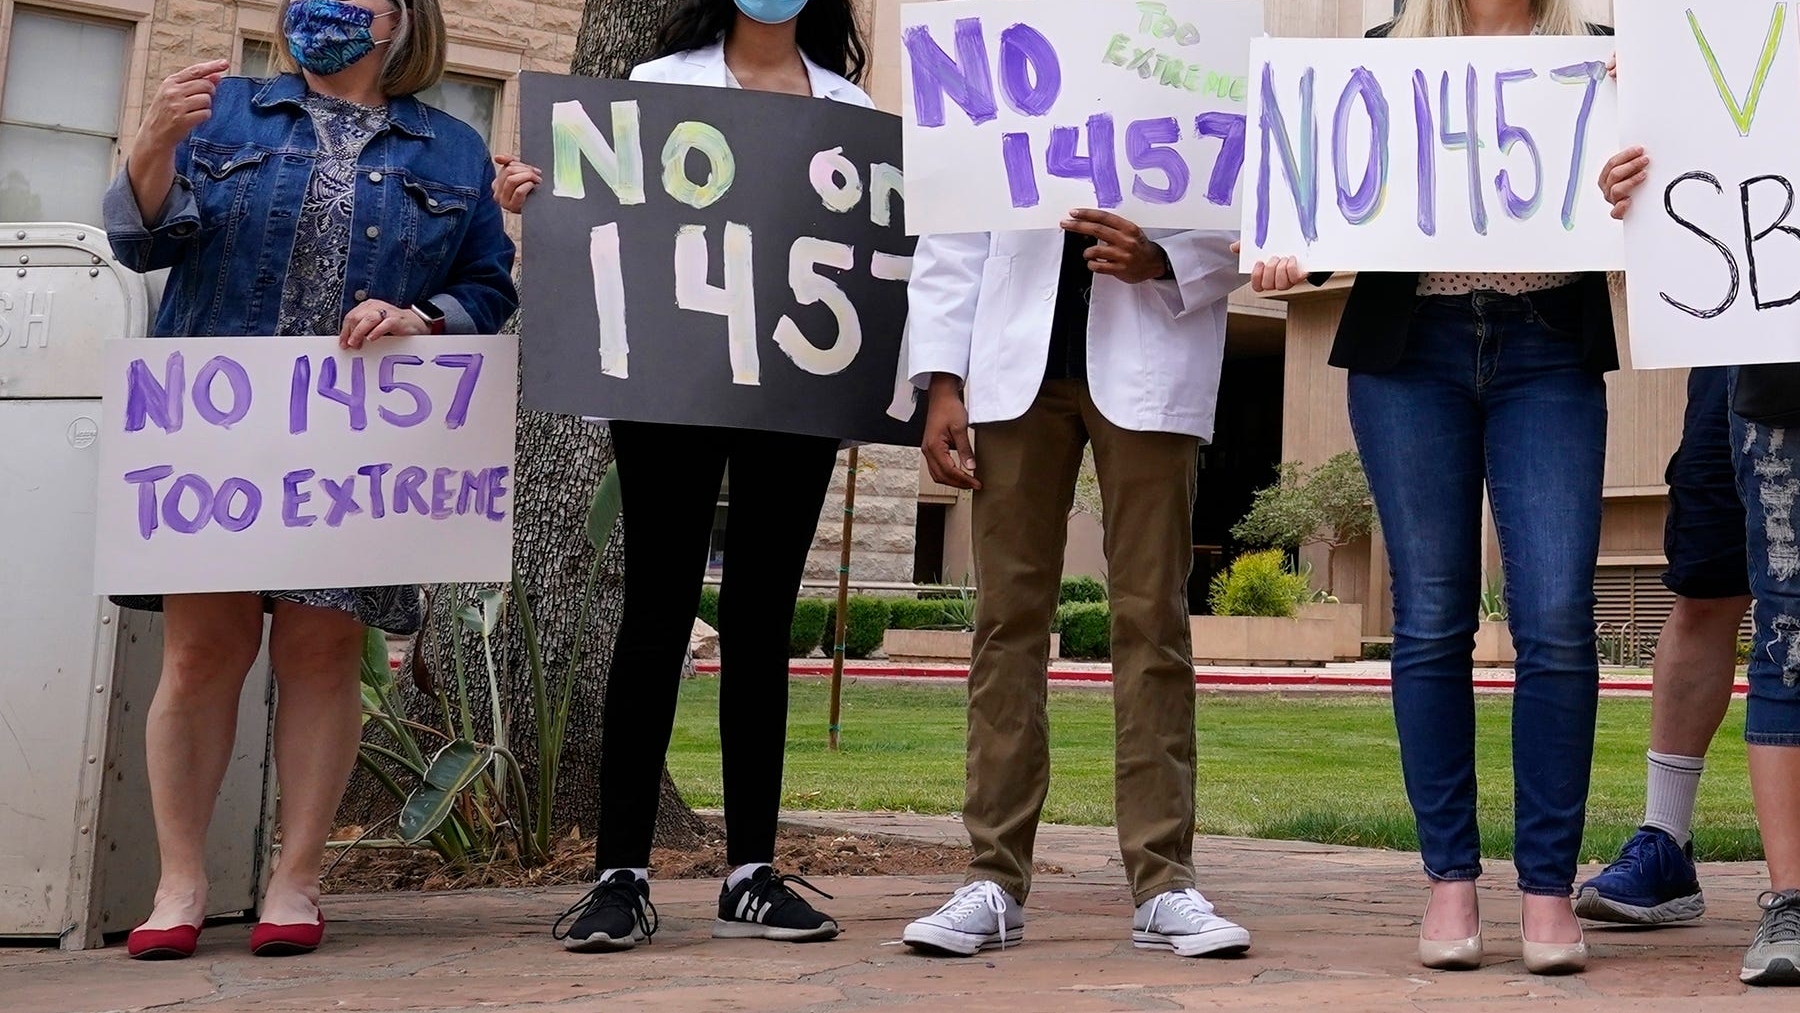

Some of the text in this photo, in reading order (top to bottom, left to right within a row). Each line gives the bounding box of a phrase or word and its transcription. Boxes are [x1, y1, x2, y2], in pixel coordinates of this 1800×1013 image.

[902, 17, 1062, 127] NO
[551, 99, 736, 210] NO
[1001, 111, 1246, 209] 1457
[1254, 60, 1608, 250] NO 1457
[124, 350, 484, 435] NO 1457
[124, 462, 509, 541] TOO EXTREME
